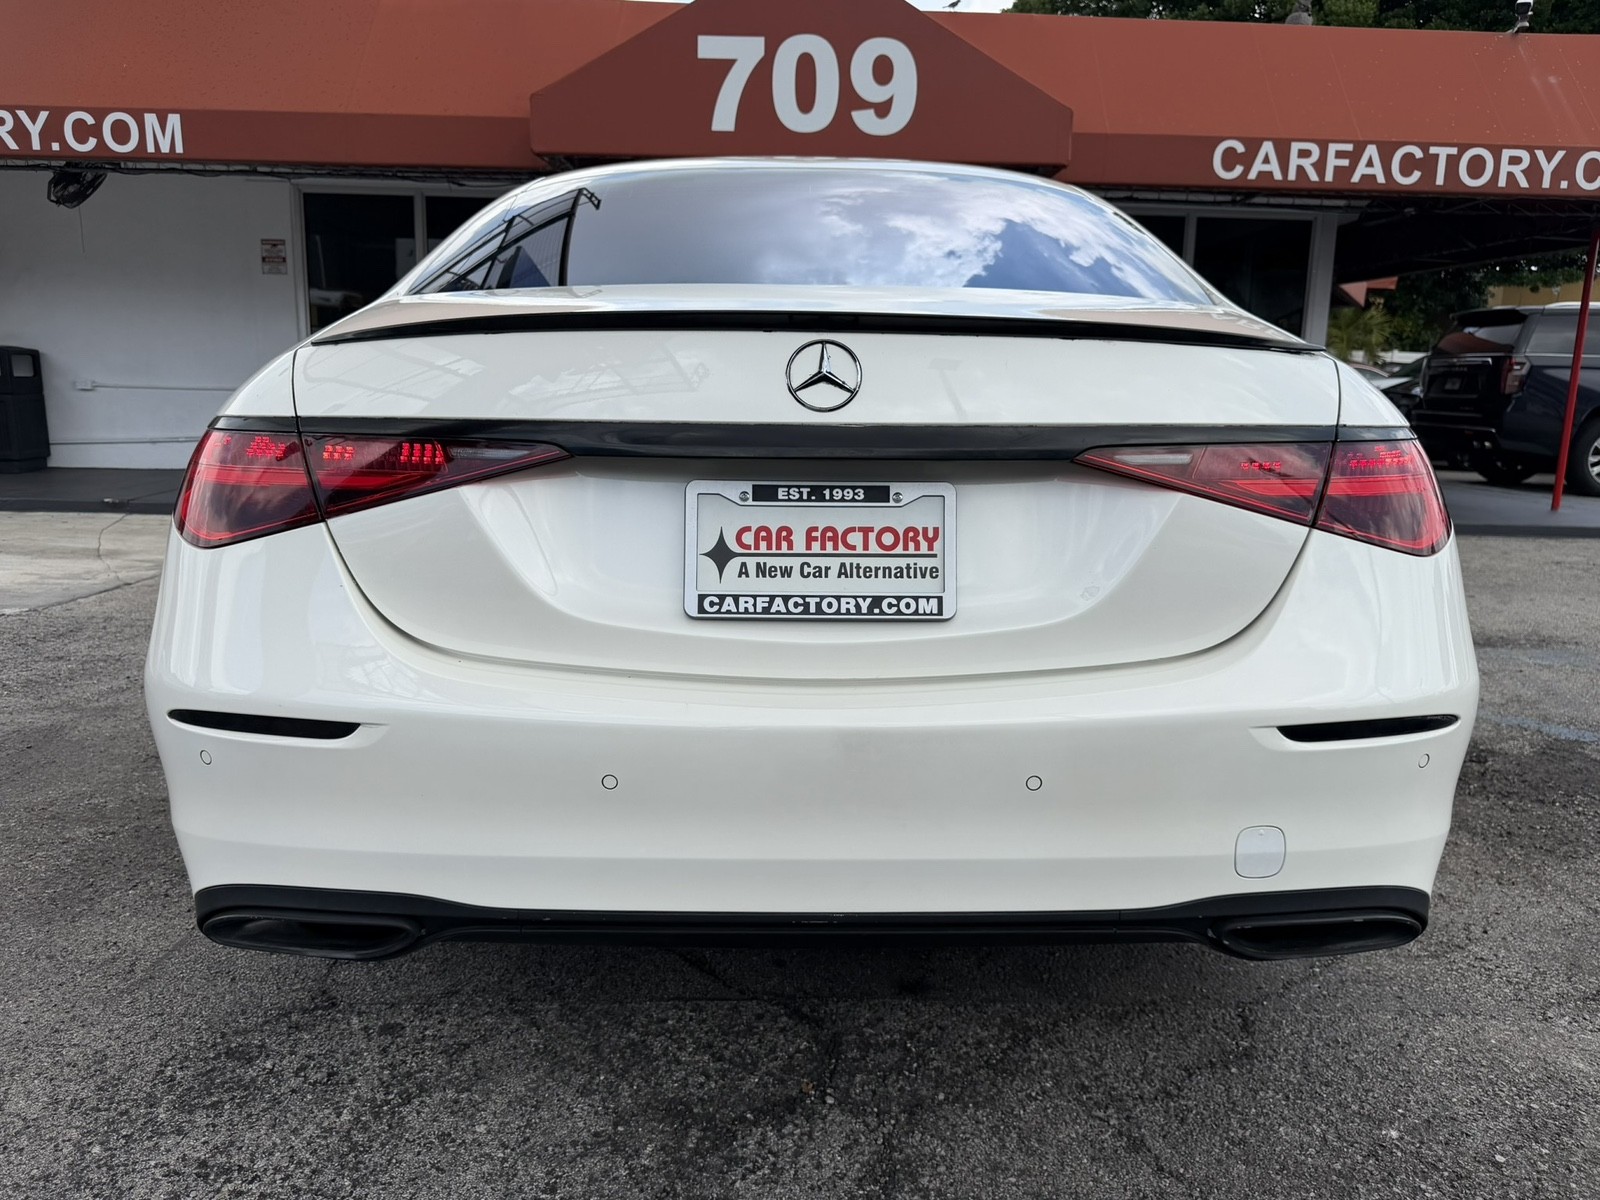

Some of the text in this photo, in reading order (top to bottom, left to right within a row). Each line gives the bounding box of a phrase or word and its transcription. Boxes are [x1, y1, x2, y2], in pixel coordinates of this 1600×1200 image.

[697, 33, 918, 136] 709
[777, 487, 865, 500] EST. 1993
[735, 525, 940, 552] CAR FACTORY
[737, 562, 940, 579] A New Car Alternative
[702, 596, 939, 615] CARFACTORY.COM
